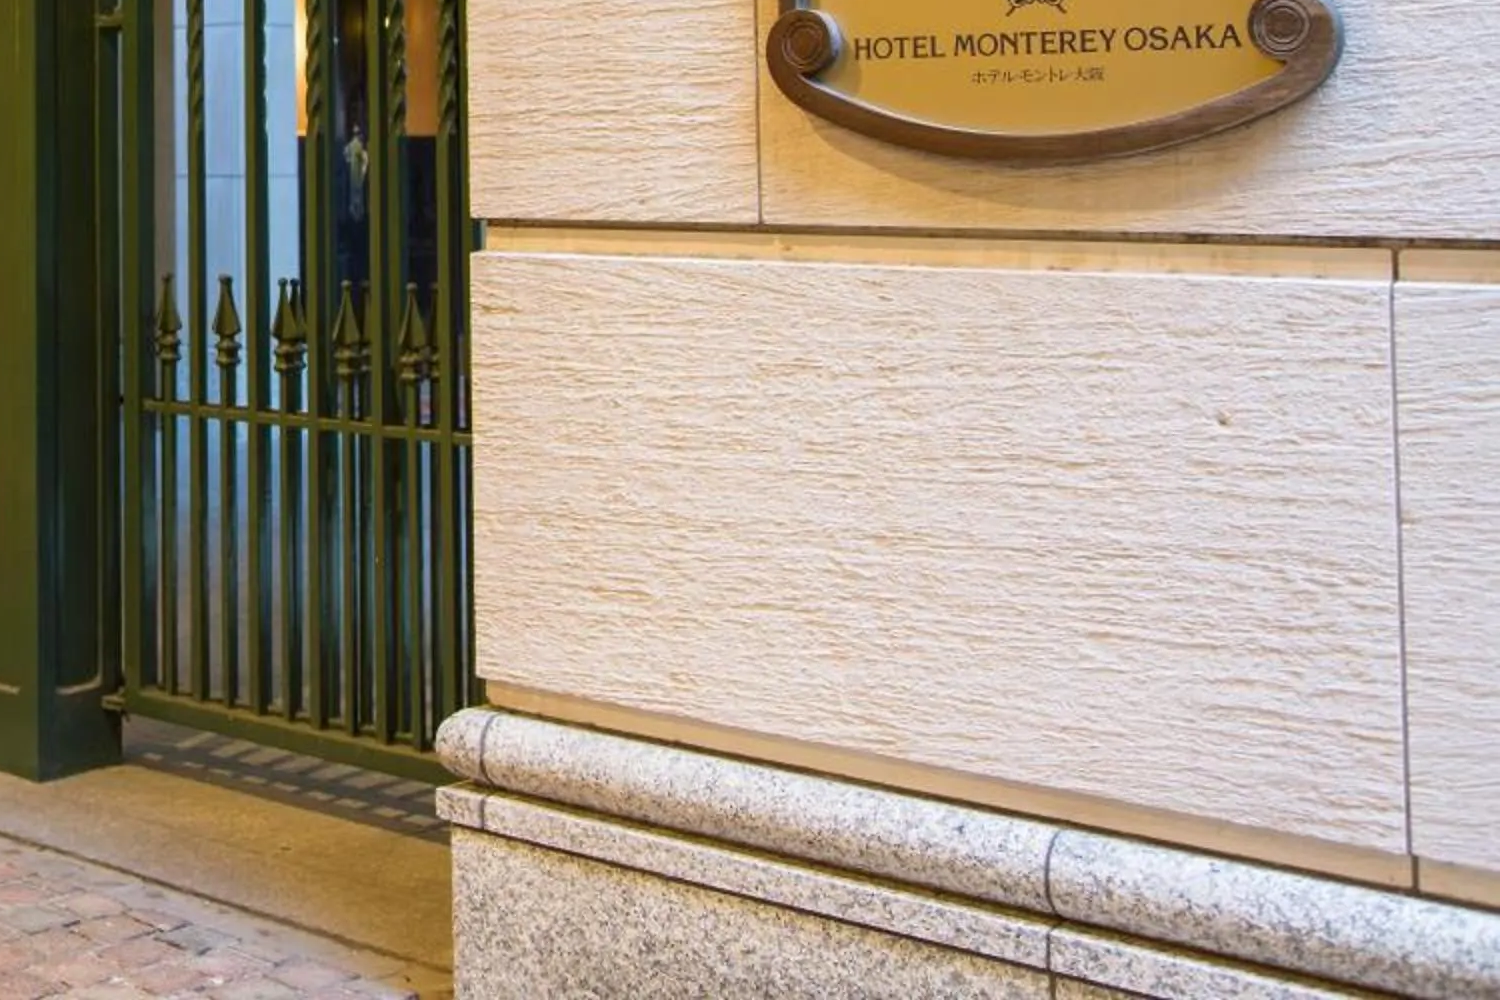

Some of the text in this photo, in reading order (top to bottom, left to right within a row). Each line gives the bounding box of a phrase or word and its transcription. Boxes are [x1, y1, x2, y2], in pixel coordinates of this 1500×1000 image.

[854, 23, 1242, 61] HOTEL MONTEREY OSAKA
